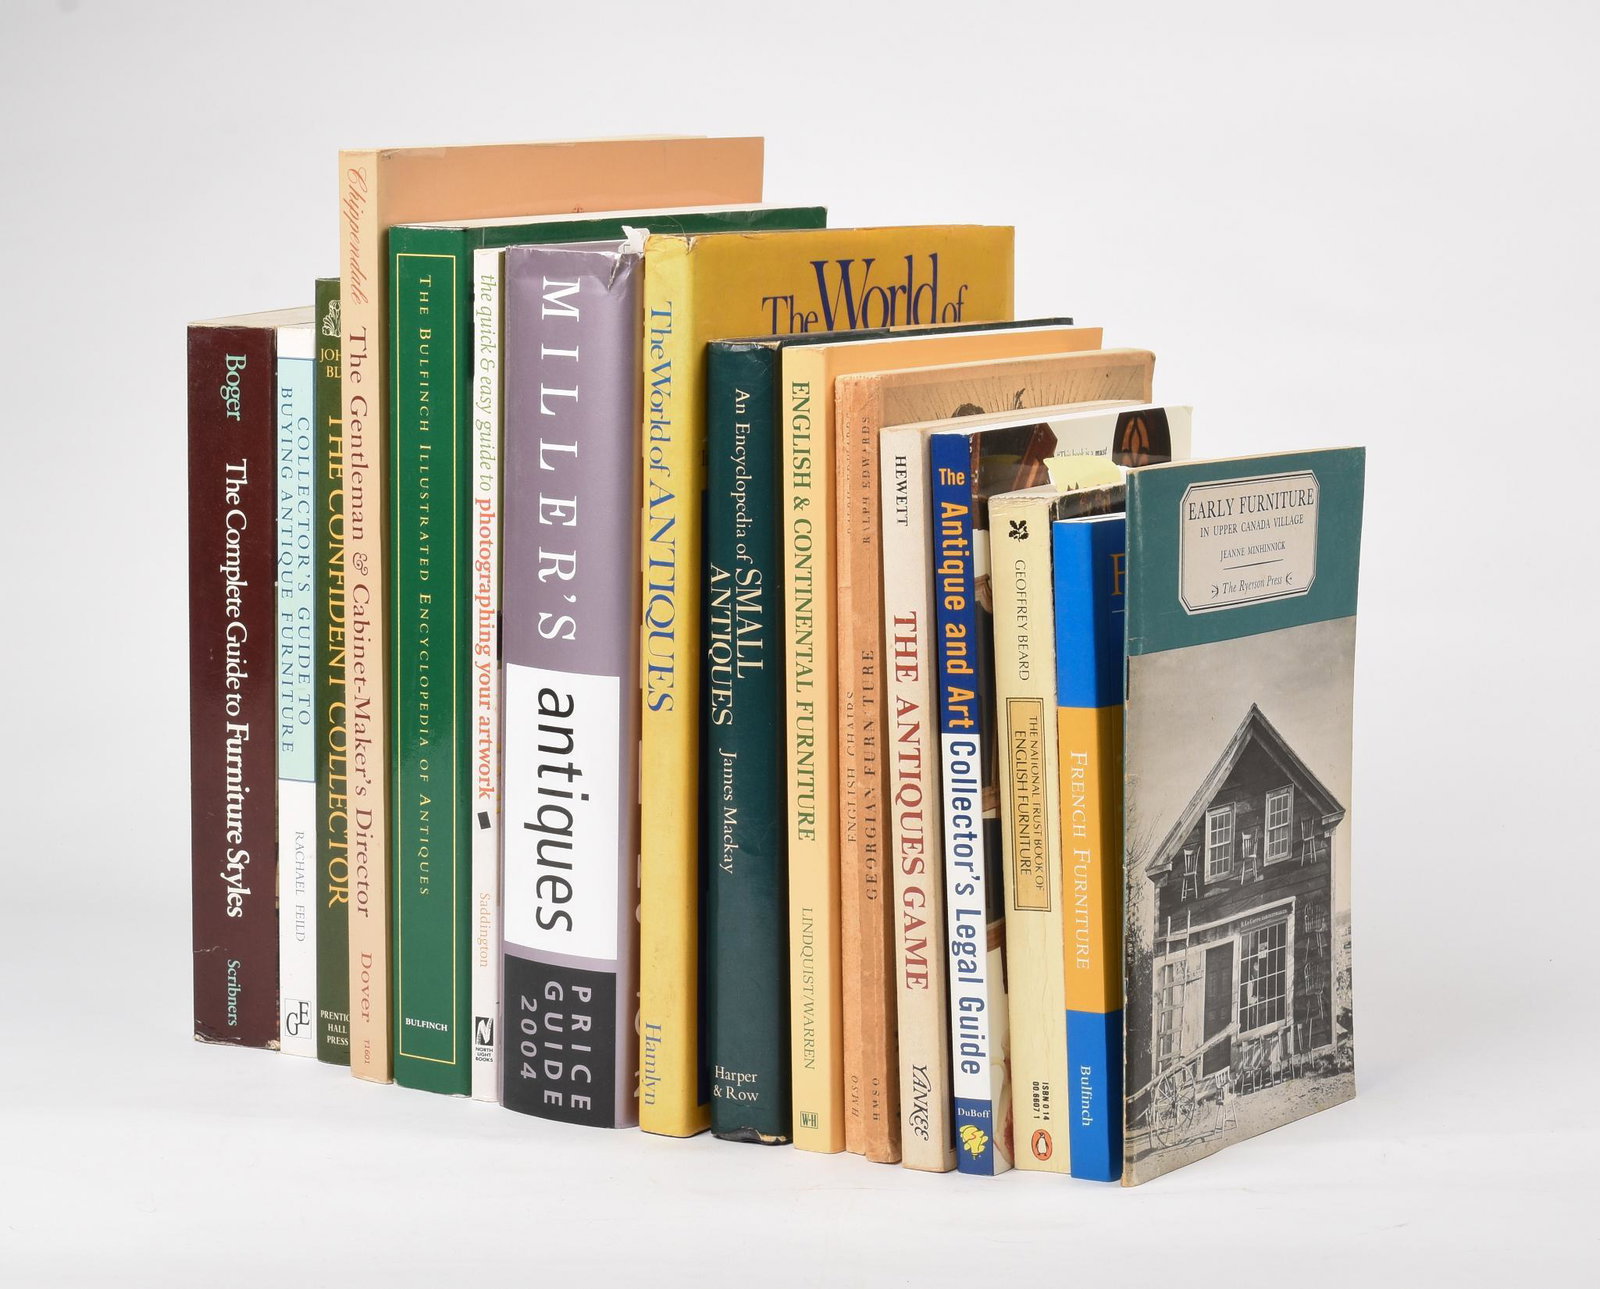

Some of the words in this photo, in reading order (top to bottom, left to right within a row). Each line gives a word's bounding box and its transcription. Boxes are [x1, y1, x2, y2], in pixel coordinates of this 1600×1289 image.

[342, 168, 368, 305] Chippendale
[418, 275, 431, 315] THE
[480, 273, 496, 301] the
[761, 294, 818, 335] The
[810, 253, 938, 332] World
[942, 284, 968, 323] of
[349, 326, 368, 383] The
[475, 305, 496, 353] quick
[480, 358, 494, 371] &
[650, 300, 672, 359] The
[219, 353, 248, 422] Boger
[419, 328, 432, 432] BULFINCH
[475, 375, 492, 415] easy
[649, 360, 672, 443] World
[735, 388, 751, 414] An
[281, 387, 294, 480] BUYING
[349, 395, 370, 540] Gentleman
[474, 418, 496, 471] guide
[537, 276, 580, 640] MILLER'S
[648, 444, 671, 477] of
[792, 381, 812, 489] ENGLISH
[225, 459, 248, 505] The
[297, 417, 310, 593] COLLECTOR'S
[418, 444, 432, 581] ILLUSTRATED
[479, 473, 492, 492] to
[731, 421, 752, 537] Encyclopedia
[793, 495, 811, 511] &
[895, 455, 909, 527] HEWETT
[938, 468, 965, 486] The
[1188, 497, 1234, 521] EARLY
[1239, 488, 1314, 514] FURNITURE
[278, 489, 294, 599] ANTIQUE
[735, 542, 754, 565] of
[938, 501, 970, 610] Antique
[1200, 526, 1210, 538] IN
[1213, 522, 1238, 536] UPPER
[1241, 519, 1271, 533] CANADA
[1273, 514, 1304, 528] VILLAGE
[1220, 545, 1245, 562] JEANNE
[219, 509, 248, 618] Complete
[328, 490, 345, 686] CONFIDENT
[352, 552, 369, 576] &
[474, 498, 496, 656] photographing
[645, 480, 676, 712] ANTIQUES
[1015, 559, 1031, 630] GEOFFREY
[1222, 581, 1237, 594] The
[1239, 578, 1265, 595] Ryerson
[1266, 575, 1283, 589] Press
[735, 568, 763, 679] SMALL
[793, 518, 814, 693] CONTINENTAL
[225, 621, 249, 693] Guide
[297, 607, 310, 684] GUIDE
[418, 594, 432, 747] ENCYCLOPEDIA
[708, 563, 733, 726] ANTIQUES
[893, 611, 919, 683] THE
[945, 623, 974, 674] and
[1017, 635, 1030, 681] BEARD
[225, 693, 242, 717] to
[281, 612, 294, 752] FURNITURE
[297, 694, 310, 726] TO
[352, 583, 372, 797] Cabinet-Maker's
[474, 661, 491, 714] your
[947, 686, 975, 729] Art
[477, 716, 495, 800] artwork
[1015, 730, 1029, 789] ENGLISH
[1029, 715, 1038, 736] THE
[225, 722, 250, 844] Furniture
[419, 759, 429, 783] OF
[719, 748, 737, 801] James
[796, 701, 816, 842] FURNITURE
[895, 695, 926, 875] ANTIQUES
[1030, 739, 1041, 798] NATIONAL
[1070, 751, 1088, 838] FRENCH
[327, 700, 348, 909] COLLECTOR
[523, 687, 590, 932] antiques
[949, 741, 982, 896] Collector's
[1017, 792, 1032, 876] FURNITURE
[1032, 802, 1043, 838] TRUST
[295, 831, 305, 896] RACHAEL
[355, 808, 373, 919] Director
[417, 794, 432, 896] ANTIQUES
[719, 806, 738, 875] Mackay
[1034, 839, 1044, 872] BOOK
[220, 849, 252, 918] Styles
[1035, 876, 1045, 891] OF
[1073, 848, 1091, 969] FURNITURE
[295, 905, 305, 942] FEILD
[476, 892, 491, 968] Saddington
[902, 886, 929, 991] GAME
[951, 908, 984, 984] Legal
[227, 959, 241, 1027] Scribners
[320, 1009, 350, 1022] PRENTIC
[360, 952, 373, 1023] Dover
[800, 907, 815, 1070] LINDQUIST/WARREN
[326, 1035, 349, 1046] PRESS
[328, 1023, 347, 1034] HALL
[405, 1017, 448, 1032] BULFINCH
[520, 995, 538, 1080] 2004
[543, 981, 563, 1107] GUIDE
[571, 985, 592, 1111] PRICE
[958, 996, 987, 1076] Guide
[644, 1022, 662, 1106] Hamlyn
[713, 1085, 723, 1098] &
[726, 1085, 759, 1102] Row
[714, 1065, 758, 1084] Harper
[1042, 1082, 1050, 1102] ISBN
[1080, 1065, 1094, 1126] Bulfinch
[908, 1064, 932, 1142] YANKEE
[957, 1107, 990, 1119] DuBoff
[1042, 1112, 1050, 1121] 14
